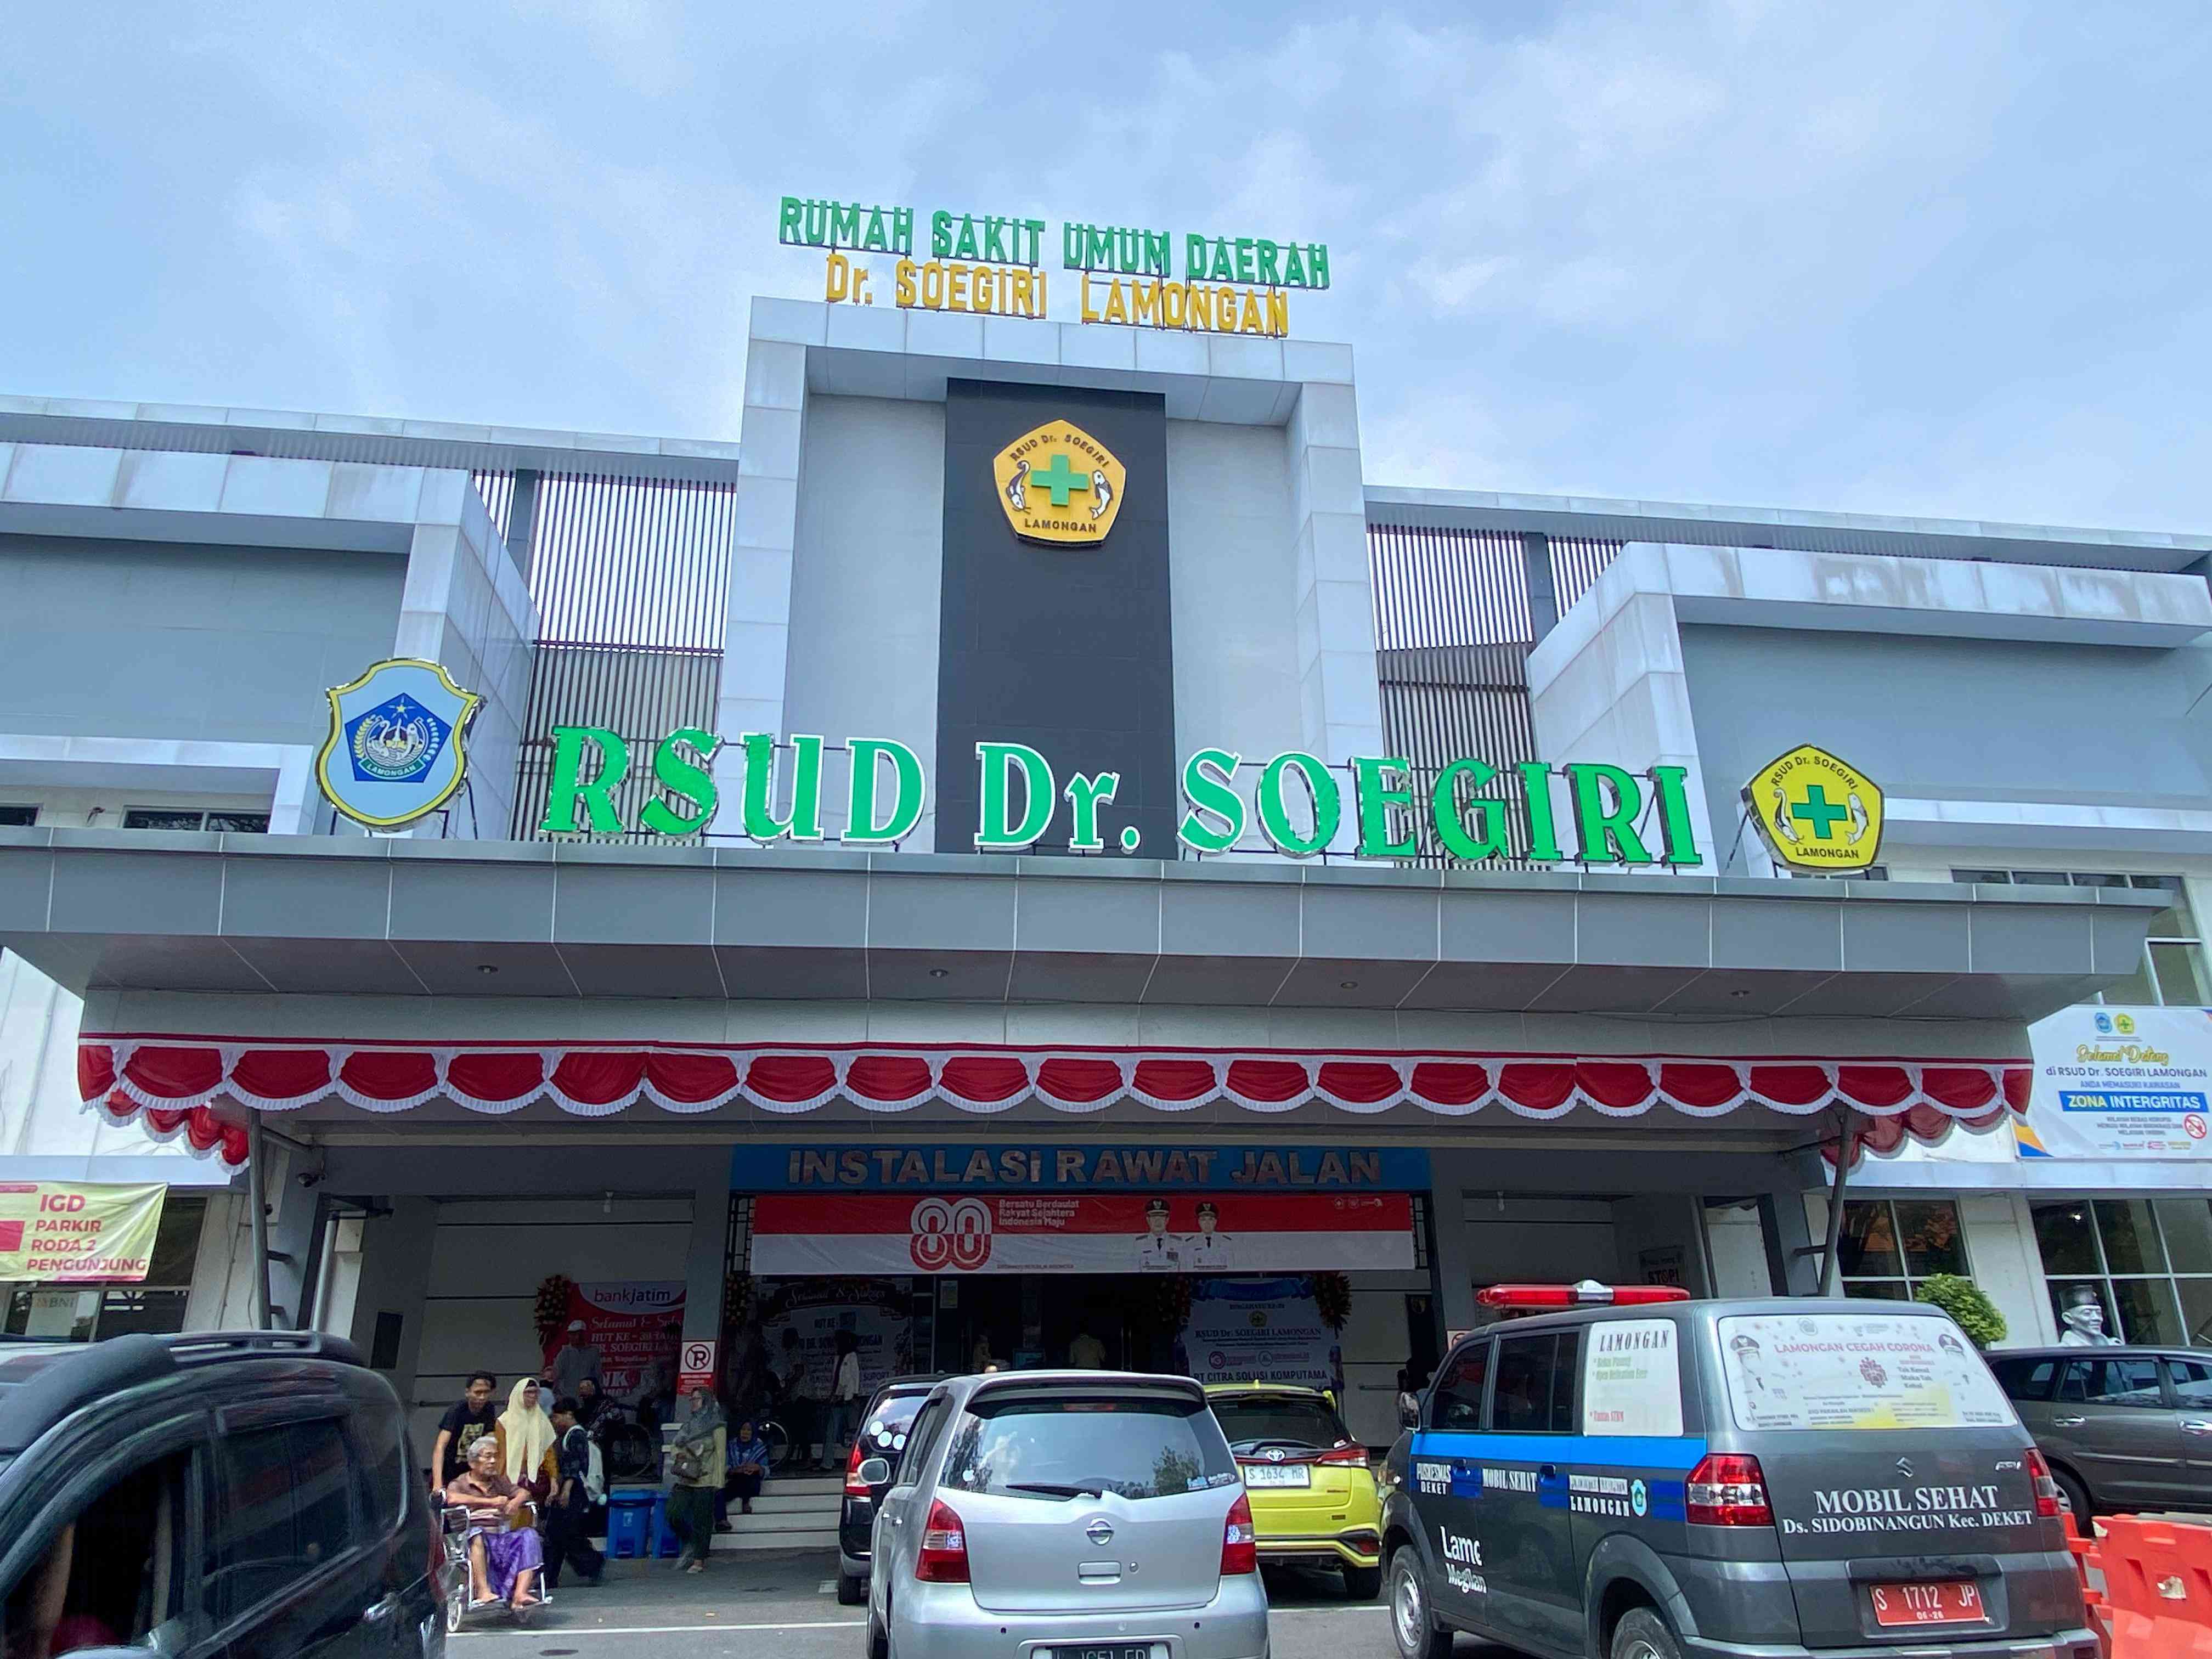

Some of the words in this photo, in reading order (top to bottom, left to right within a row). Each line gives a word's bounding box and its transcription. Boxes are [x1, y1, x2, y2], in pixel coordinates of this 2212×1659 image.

[780, 196, 913, 254] RUMAH
[932, 210, 1045, 266] SAKIT
[1063, 222, 1171, 276] UMUM
[1186, 233, 1330, 289] DAERAH
[826, 253, 872, 303] Dr.
[896, 259, 1047, 318] SOEGIRI
[1082, 272, 1289, 337] LAMONGAN
[1009, 439, 1038, 461] RSUD
[1064, 435, 1110, 467] SOEGIRI
[1024, 518, 1096, 533] LAMONGAN
[366, 764, 416, 776] LAMONGAN
[1770, 761, 1793, 786] RSUD
[1814, 757, 1859, 790] SOEGIRI
[539, 725, 927, 845] RSUD
[973, 741, 1142, 851] Dr.
[1177, 747, 1703, 867] SOEGIRI
[1795, 847, 1859, 859] LAMONGAN
[2076, 1044, 2122, 1063] Selamat
[2123, 1044, 2169, 1066] Datang
[2046, 1067, 2056, 1076] di
[2059, 1068, 2085, 1076] RSUD
[2106, 1068, 2145, 1077] SOEGIRI
[2147, 1068, 2207, 1077] LAMONGAN
[2067, 1094, 2107, 1108] ZONA
[2109, 1095, 2201, 1109] INTERGRITAS
[788, 1149, 1042, 1183] INSTALASI
[1056, 1150, 1218, 1184] RAWAT
[1230, 1150, 1382, 1186] JALAN
[39, 1194, 86, 1212] IGD
[999, 1199, 1034, 1208] Bersatu
[1036, 1199, 1080, 1208] Berdaulat
[999, 1209, 1030, 1218] Rakyat
[1032, 1209, 1075, 1219] Sejahtera
[35, 1220, 102, 1232] PARKIR
[1044, 1218, 1065, 1228] Maju
[910, 1198, 992, 1271] 80
[31, 1239, 82, 1251] RODA
[85, 1239, 97, 1251] 2
[27, 1258, 146, 1271] PENGUNJUNG
[1195, 1329, 1219, 1338] RSUD
[1272, 1328, 1322, 1336] LAMONGAN
[1599, 1330, 1669, 1352] LAMONGAN
[1774, 1343, 1843, 1354] LAMONGAN
[1847, 1343, 1885, 1352] CEGAH
[1887, 1343, 1936, 1353] CORONA
[1207, 1372, 1234, 1382] CITRA
[1236, 1371, 1268, 1381] SOLUSI
[1271, 1370, 1328, 1380] KOMPUTAMA
[1249, 1468, 1255, 1480] S
[1482, 1468, 1508, 1489] MOBIL
[1509, 1470, 1537, 1492] SEHAT
[1421, 1481, 1447, 1495] DEKET
[1570, 1496, 1629, 1516] LAMONGAN
[1814, 1488, 1912, 1514] MOBIL
[1915, 1485, 1999, 1511] SEHAT
[1784, 1520, 1808, 1534] Ds.
[1811, 1514, 1945, 1533] SIDOBINANGUN
[1949, 1514, 1979, 1528] Kec.
[1983, 1510, 2033, 1527] DEKET
[1875, 1588, 1888, 1611] S
[1902, 1585, 1943, 1611] 1712
[1959, 1585, 1975, 1608] JP
